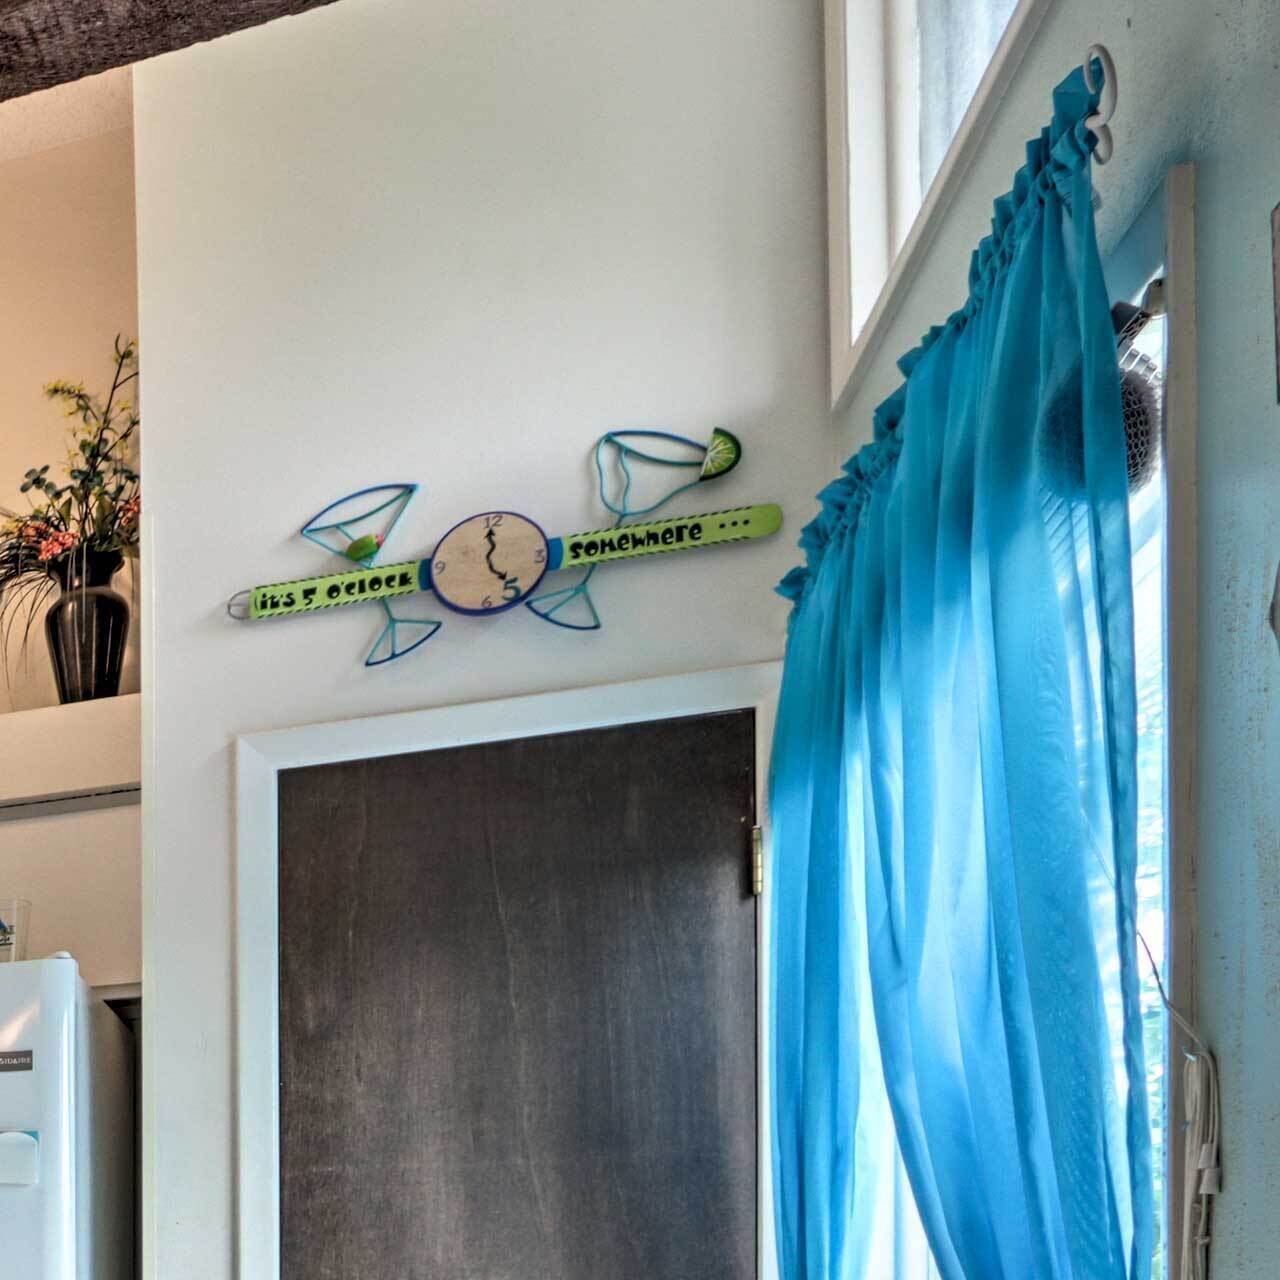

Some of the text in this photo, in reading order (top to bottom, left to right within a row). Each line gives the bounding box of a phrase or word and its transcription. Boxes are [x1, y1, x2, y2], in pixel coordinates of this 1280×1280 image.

[483, 514, 504, 529] 12
[533, 549, 546, 565] 3
[434, 560, 447, 576] 9
[302, 587, 318, 606] 5
[501, 577, 522, 602] 5
[481, 595, 493, 609] 6
